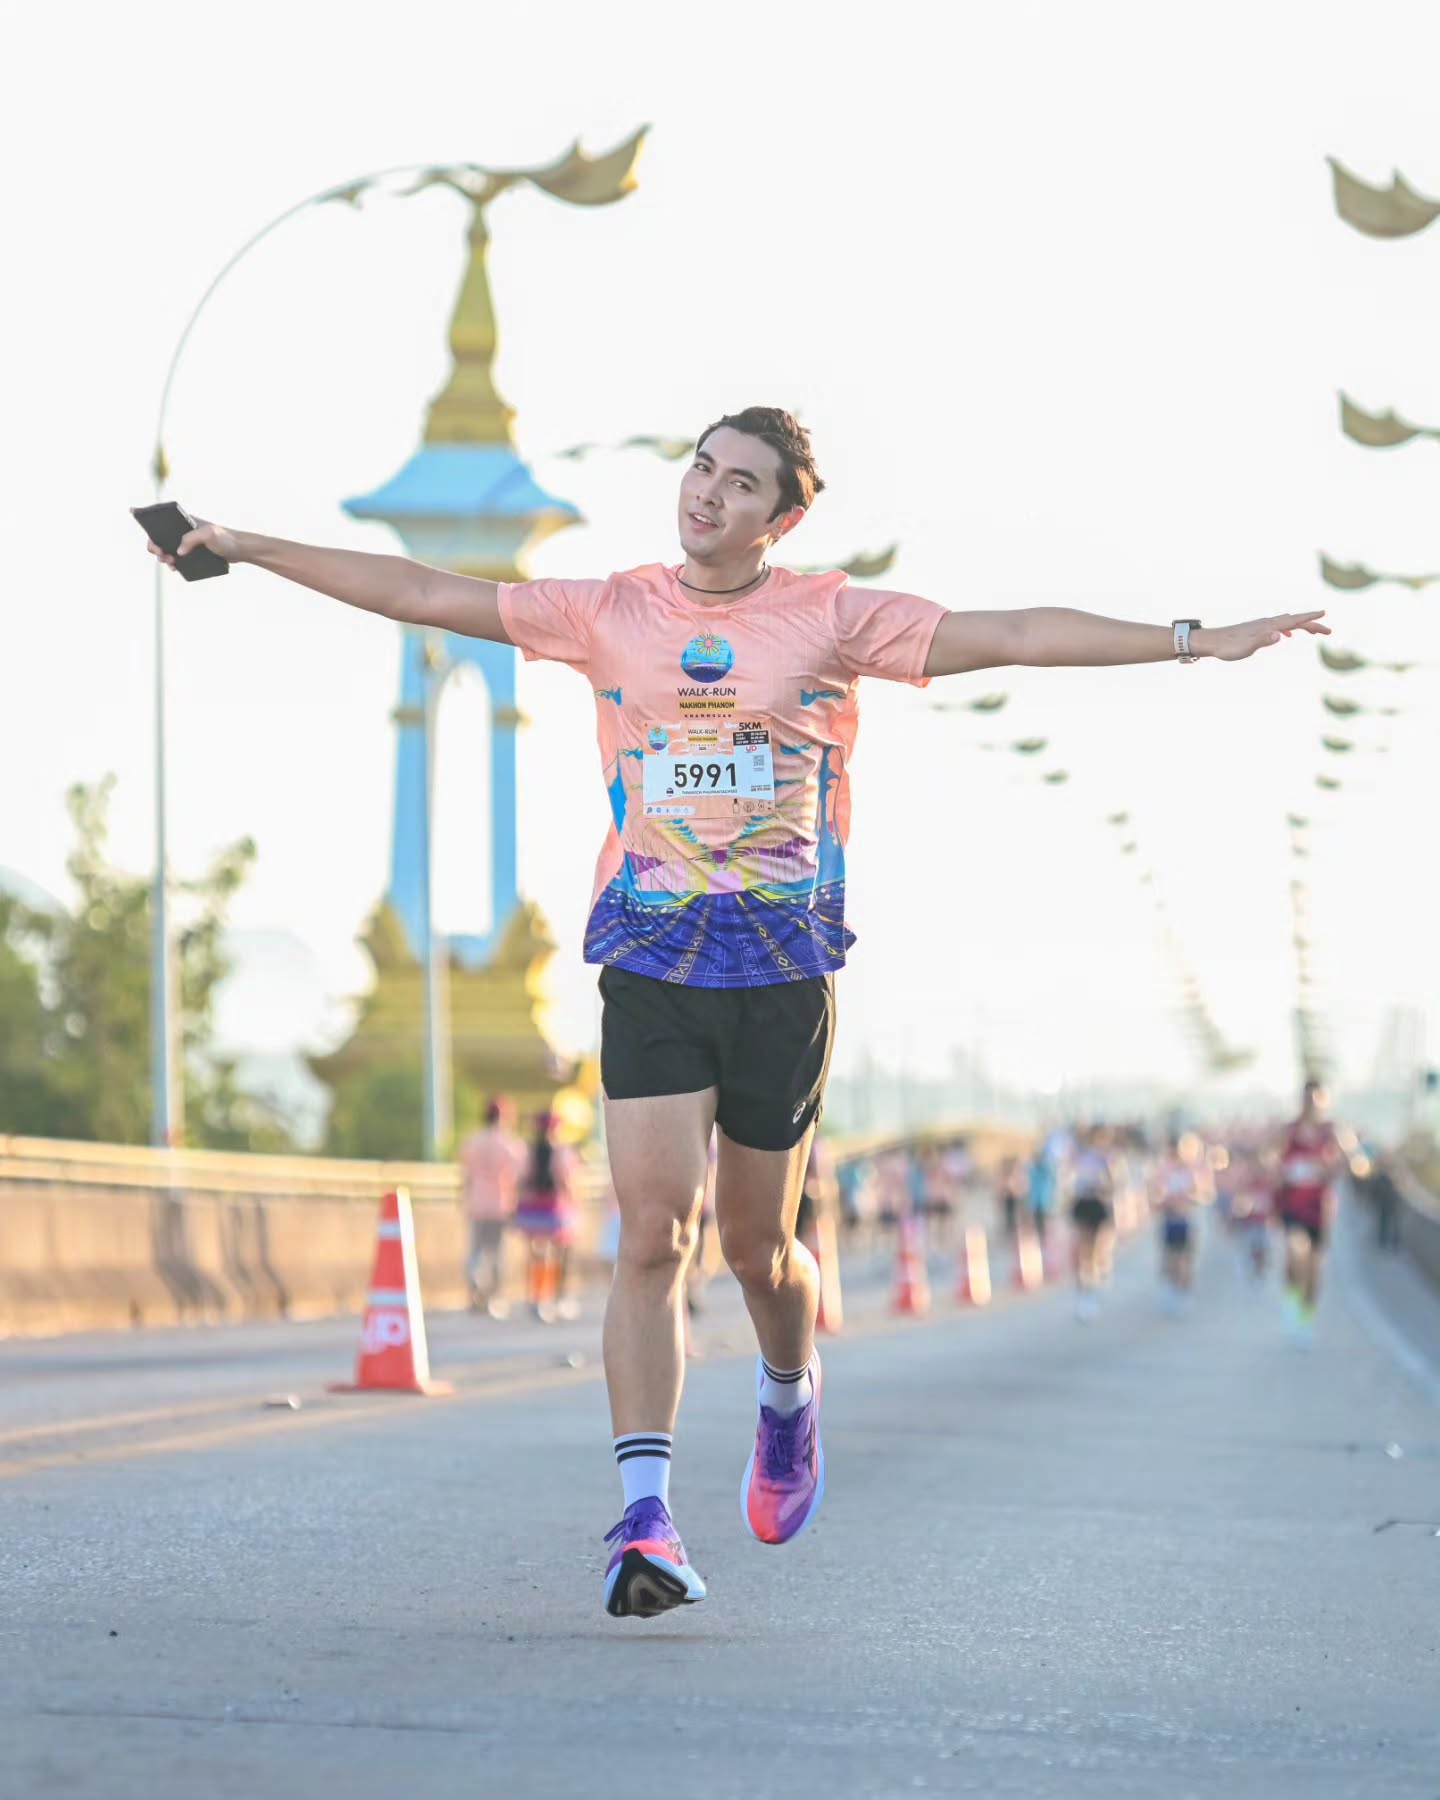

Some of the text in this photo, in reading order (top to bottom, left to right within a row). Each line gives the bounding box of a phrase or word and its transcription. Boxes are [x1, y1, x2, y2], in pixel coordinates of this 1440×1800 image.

[678, 687, 736, 697] WALK-RUN
[738, 722, 762, 731] 5KM
[674, 763, 737, 788] 5991
